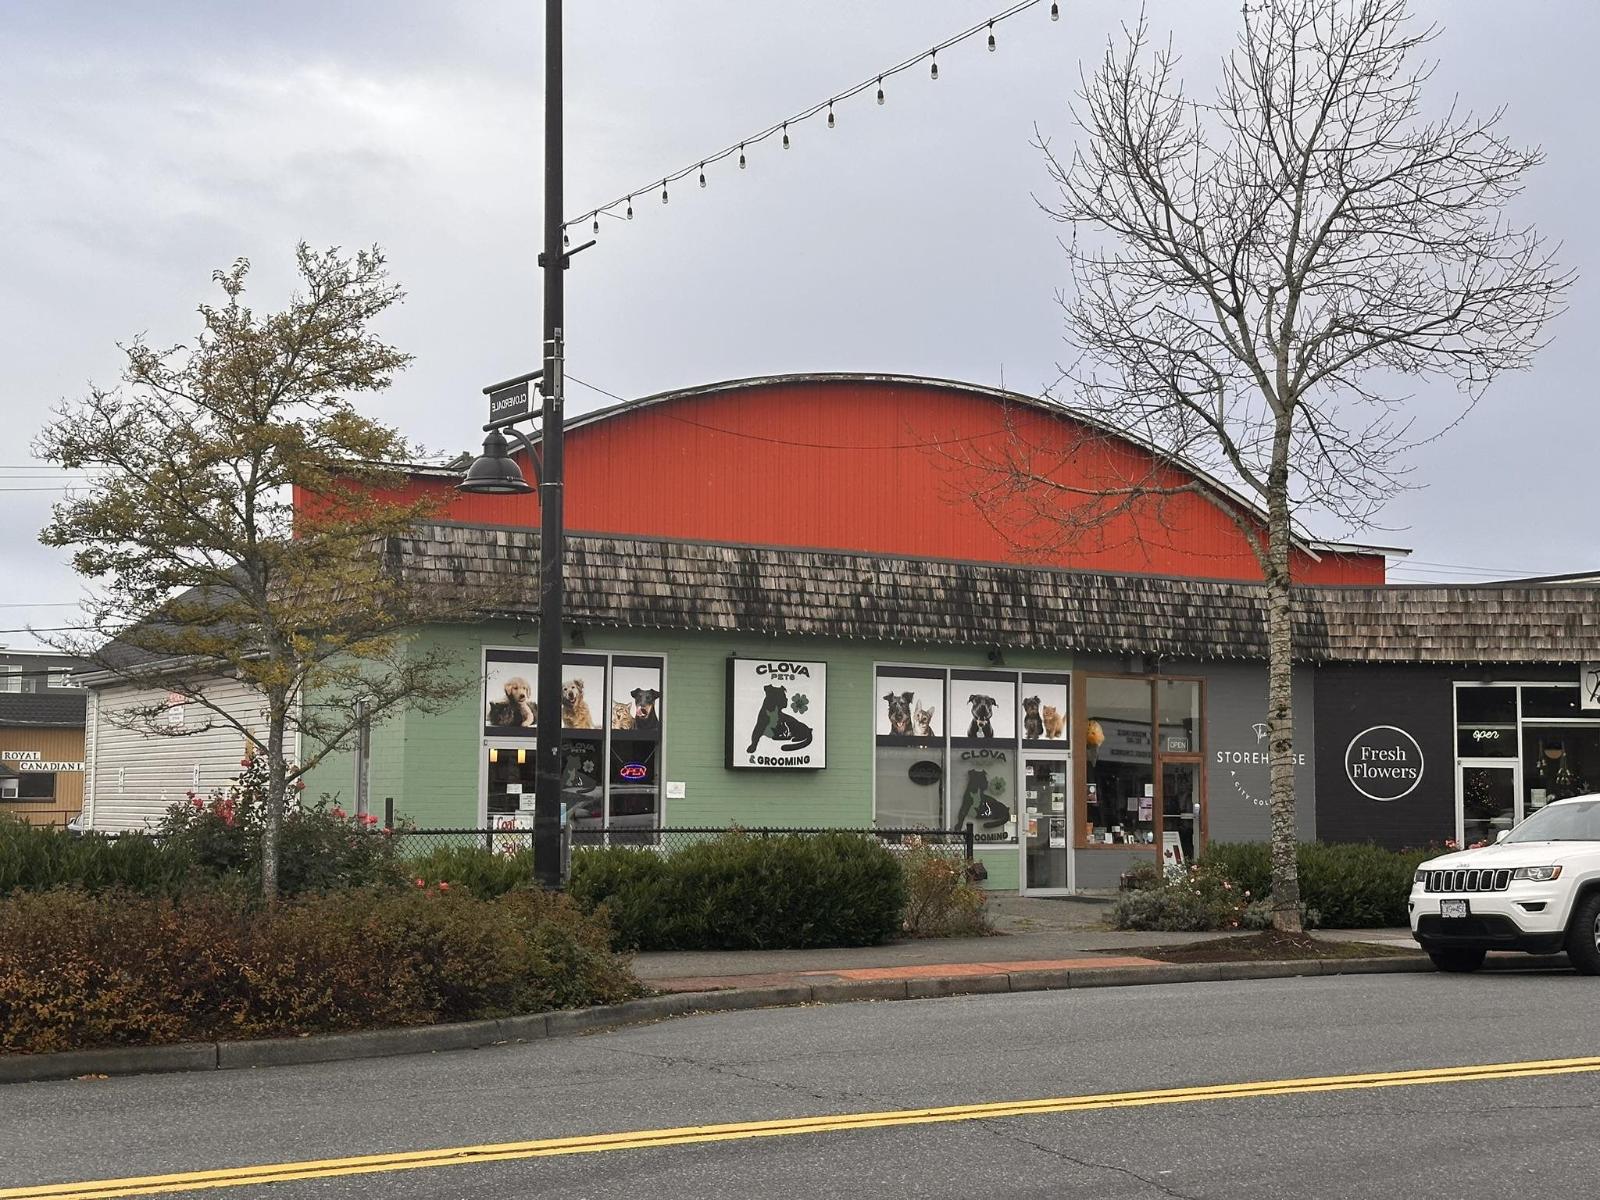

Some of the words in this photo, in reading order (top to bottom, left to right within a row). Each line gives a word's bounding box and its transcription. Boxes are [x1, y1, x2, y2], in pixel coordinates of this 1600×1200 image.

[756, 663, 811, 678] CLOVA
[1473, 730, 1499, 741] open
[561, 742, 597, 753] CLOVA
[1361, 746, 1406, 760] Fresh
[749, 755, 755, 764] &
[757, 756, 810, 766] GROOMING
[961, 749, 1006, 762] CLOVA
[1217, 752, 1305, 765] STOREHSE
[21, 762, 75, 770] CANADIAN
[620, 767, 647, 776] OPEN
[1353, 763, 1417, 778] Flowers
